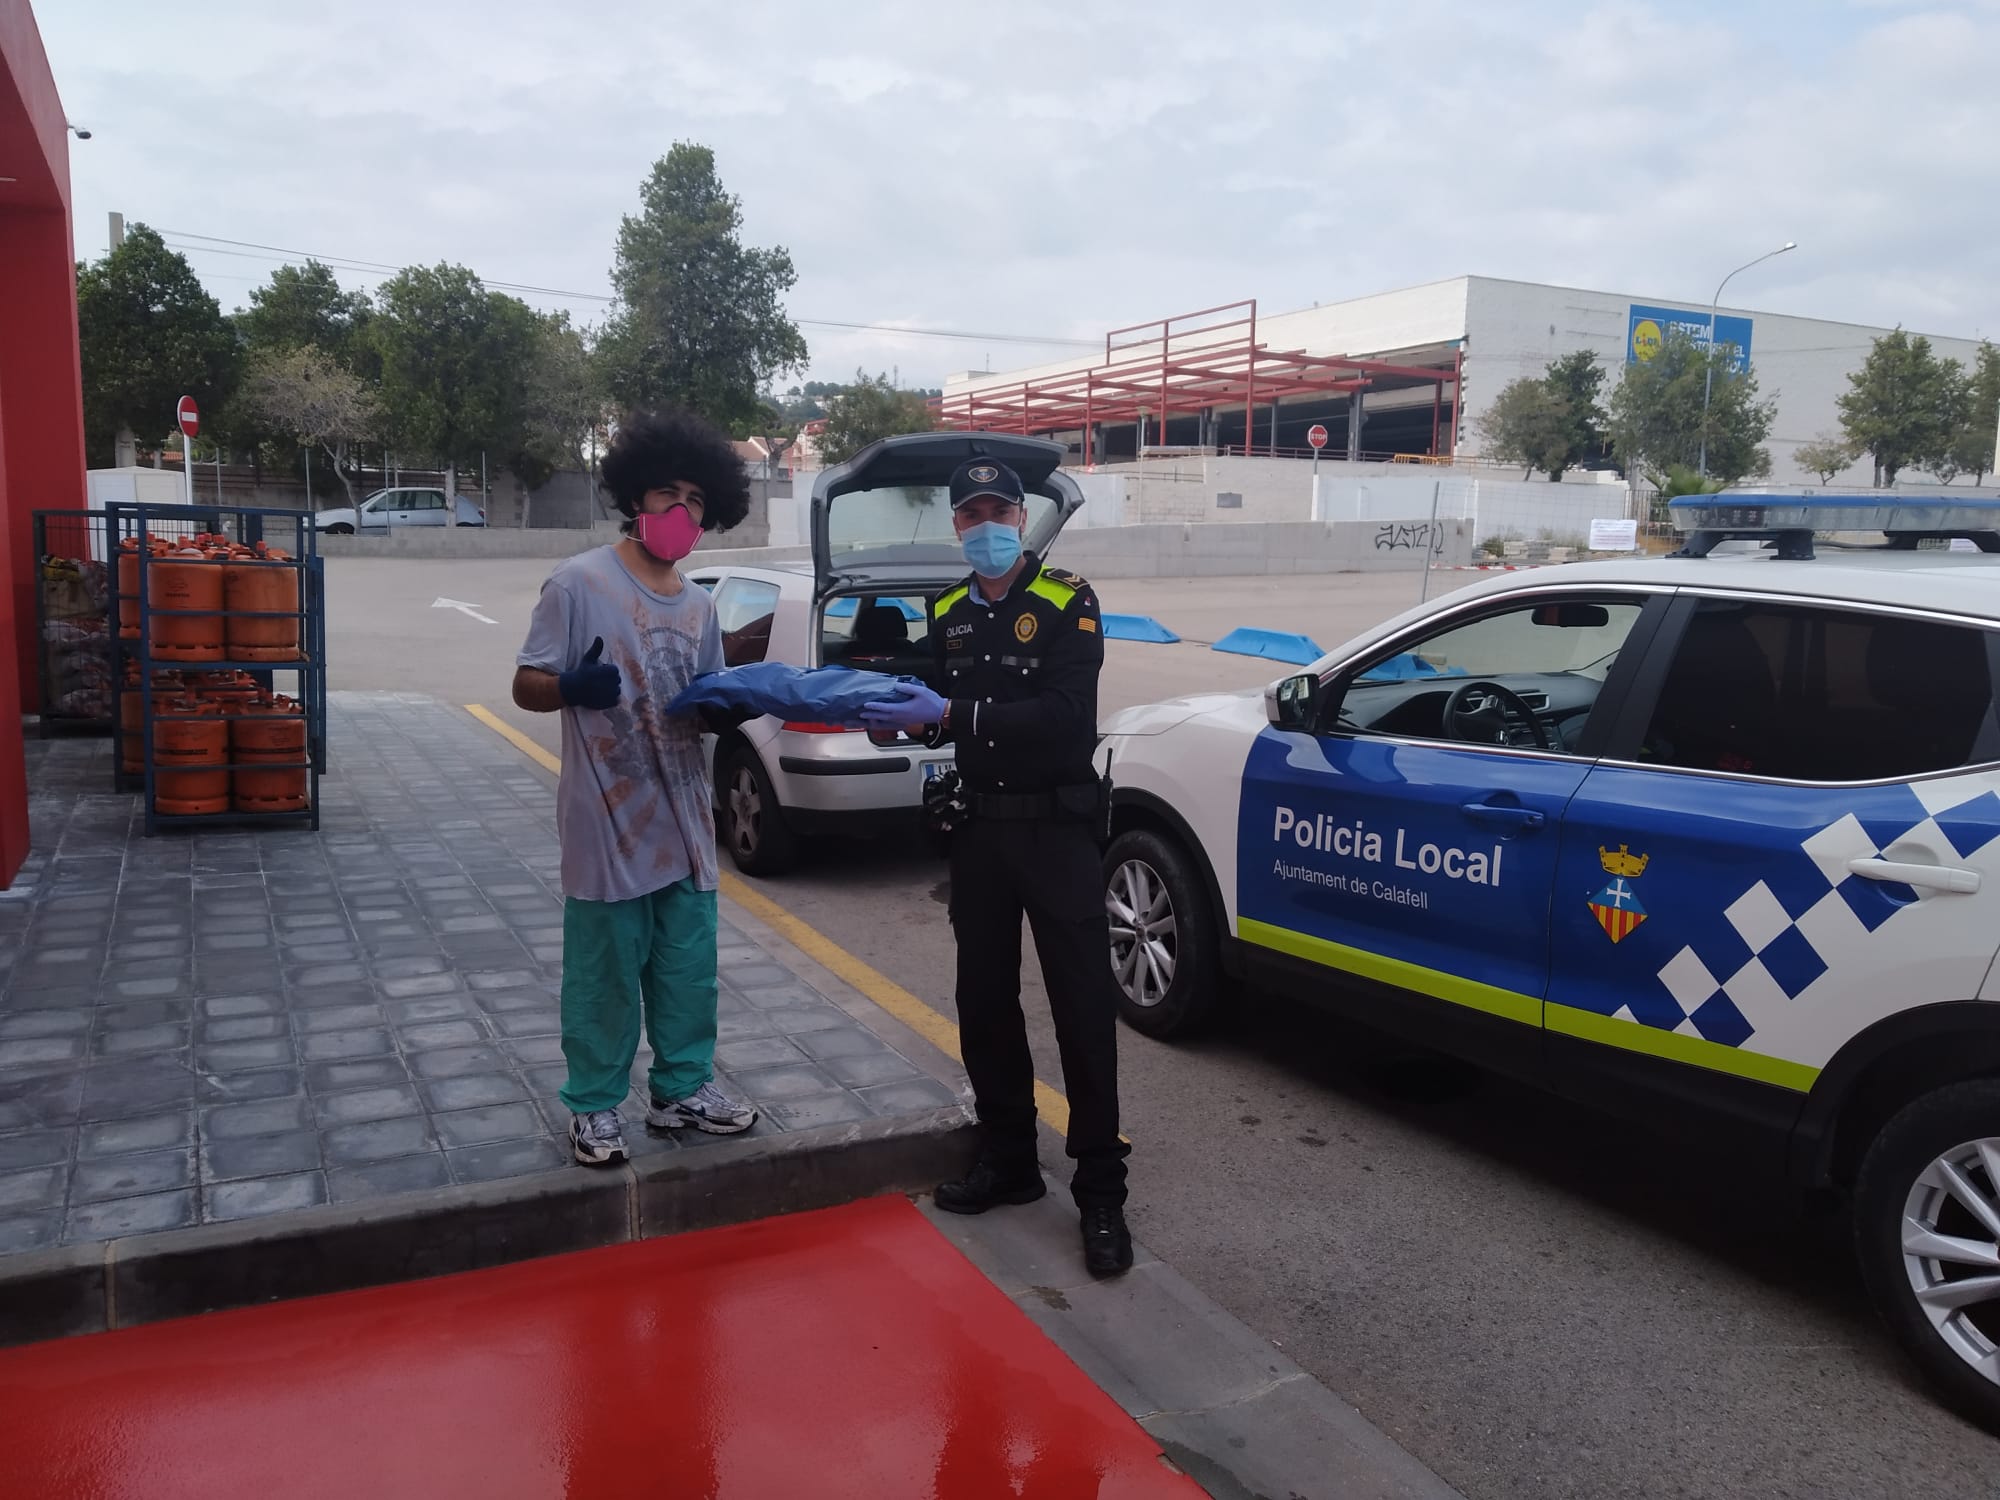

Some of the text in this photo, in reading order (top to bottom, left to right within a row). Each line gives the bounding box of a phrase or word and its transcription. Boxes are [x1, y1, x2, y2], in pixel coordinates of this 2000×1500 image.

[1310, 433, 1327, 441] STOP
[1273, 805, 1503, 887] Policia Local
[1273, 858, 1429, 910] Ajuntament de Calafell
